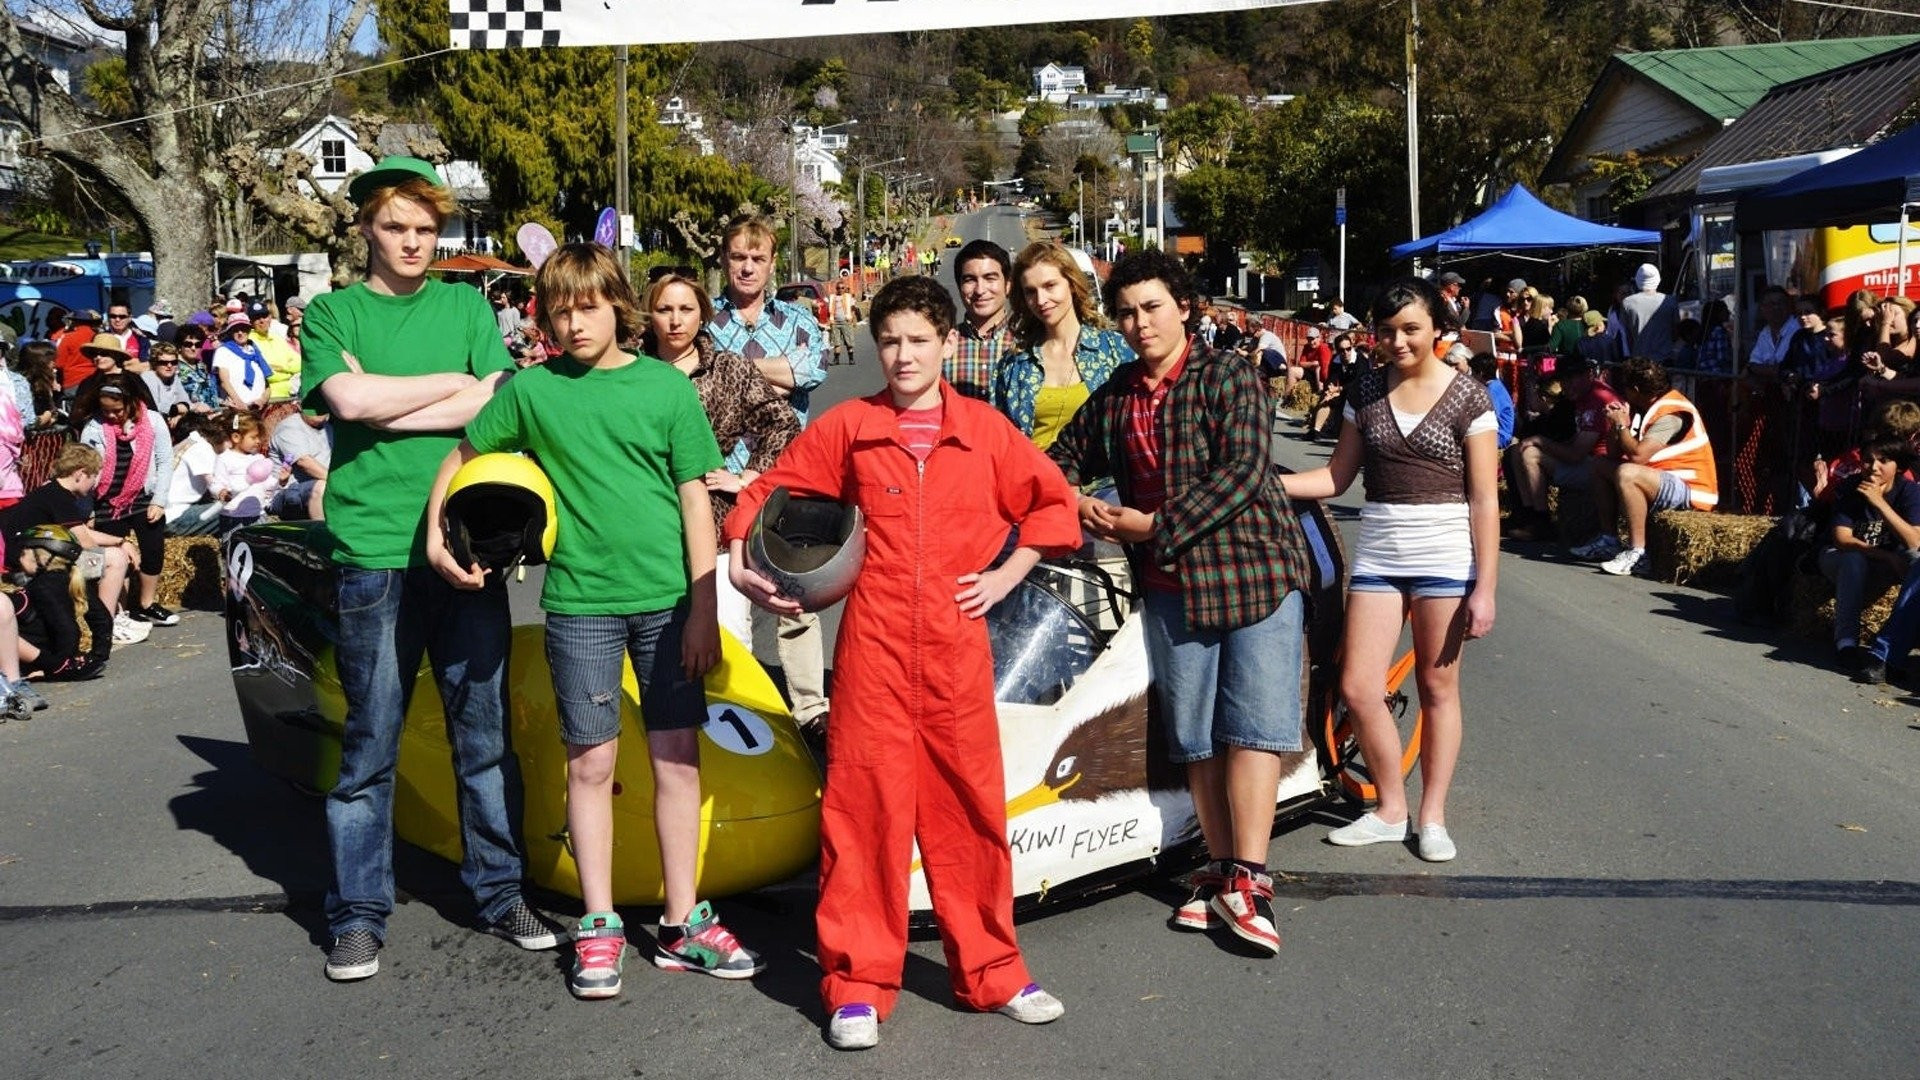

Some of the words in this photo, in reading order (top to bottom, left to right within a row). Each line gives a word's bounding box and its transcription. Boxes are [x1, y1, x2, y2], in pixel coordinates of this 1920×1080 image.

[718, 708, 759, 750] 1
[1009, 824, 1066, 854] KIWI
[1070, 818, 1139, 859] FLYER
